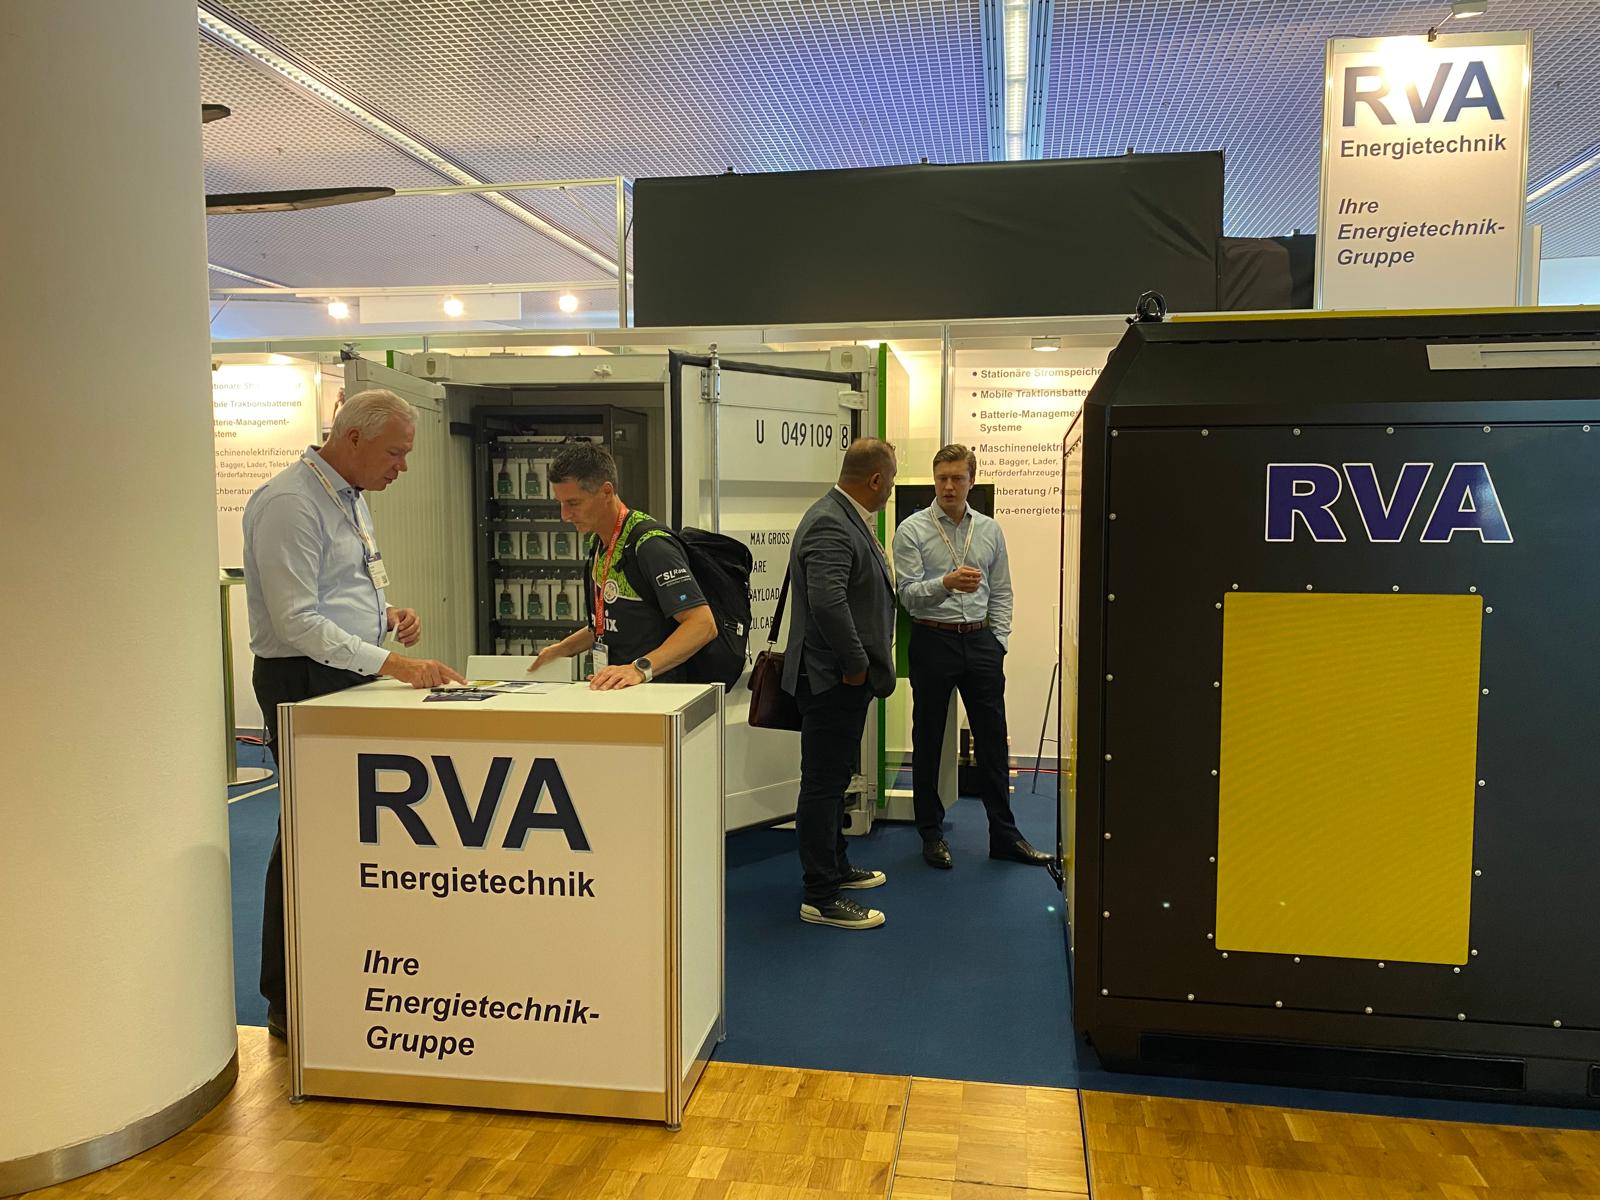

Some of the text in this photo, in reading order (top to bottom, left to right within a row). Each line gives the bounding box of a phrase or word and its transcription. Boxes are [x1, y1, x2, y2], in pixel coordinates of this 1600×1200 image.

[1342, 61, 1505, 127] RVA
[1341, 134, 1507, 160] Energietechnik
[1338, 198, 1379, 215] Ihre
[1337, 219, 1505, 242] Energietechnik-
[1337, 248, 1415, 268] Gruppe
[980, 369, 1031, 379] Stationäre
[980, 389, 1013, 400] Mobile
[230, 399, 302, 408] Traktionsbatterien
[980, 409, 1078, 420] Batterie-Manageme
[756, 419, 849, 449] U 049109 8
[979, 423, 1022, 433] Systeme
[215, 447, 305, 457] schinenelektrifizierung
[979, 442, 1063, 454] Maschinenelektri
[220, 461, 246, 469] Bagger,
[246, 461, 268, 469] Lader,
[999, 458, 1031, 467] Bagger,
[1032, 458, 1058, 466] Lader,
[216, 471, 272, 479] förderfahrzeuge)
[979, 469, 1061, 478] Flurförderfahrzeuge
[1265, 462, 1514, 544] RVA
[750, 532, 790, 545] MAX GROSS
[752, 560, 767, 573] ARE
[357, 752, 593, 853] RVA
[359, 862, 596, 898] Energietechnik
[363, 949, 420, 976] Ihre
[364, 987, 600, 1025] Energietechnik-
[366, 1025, 475, 1060] Gruppe
